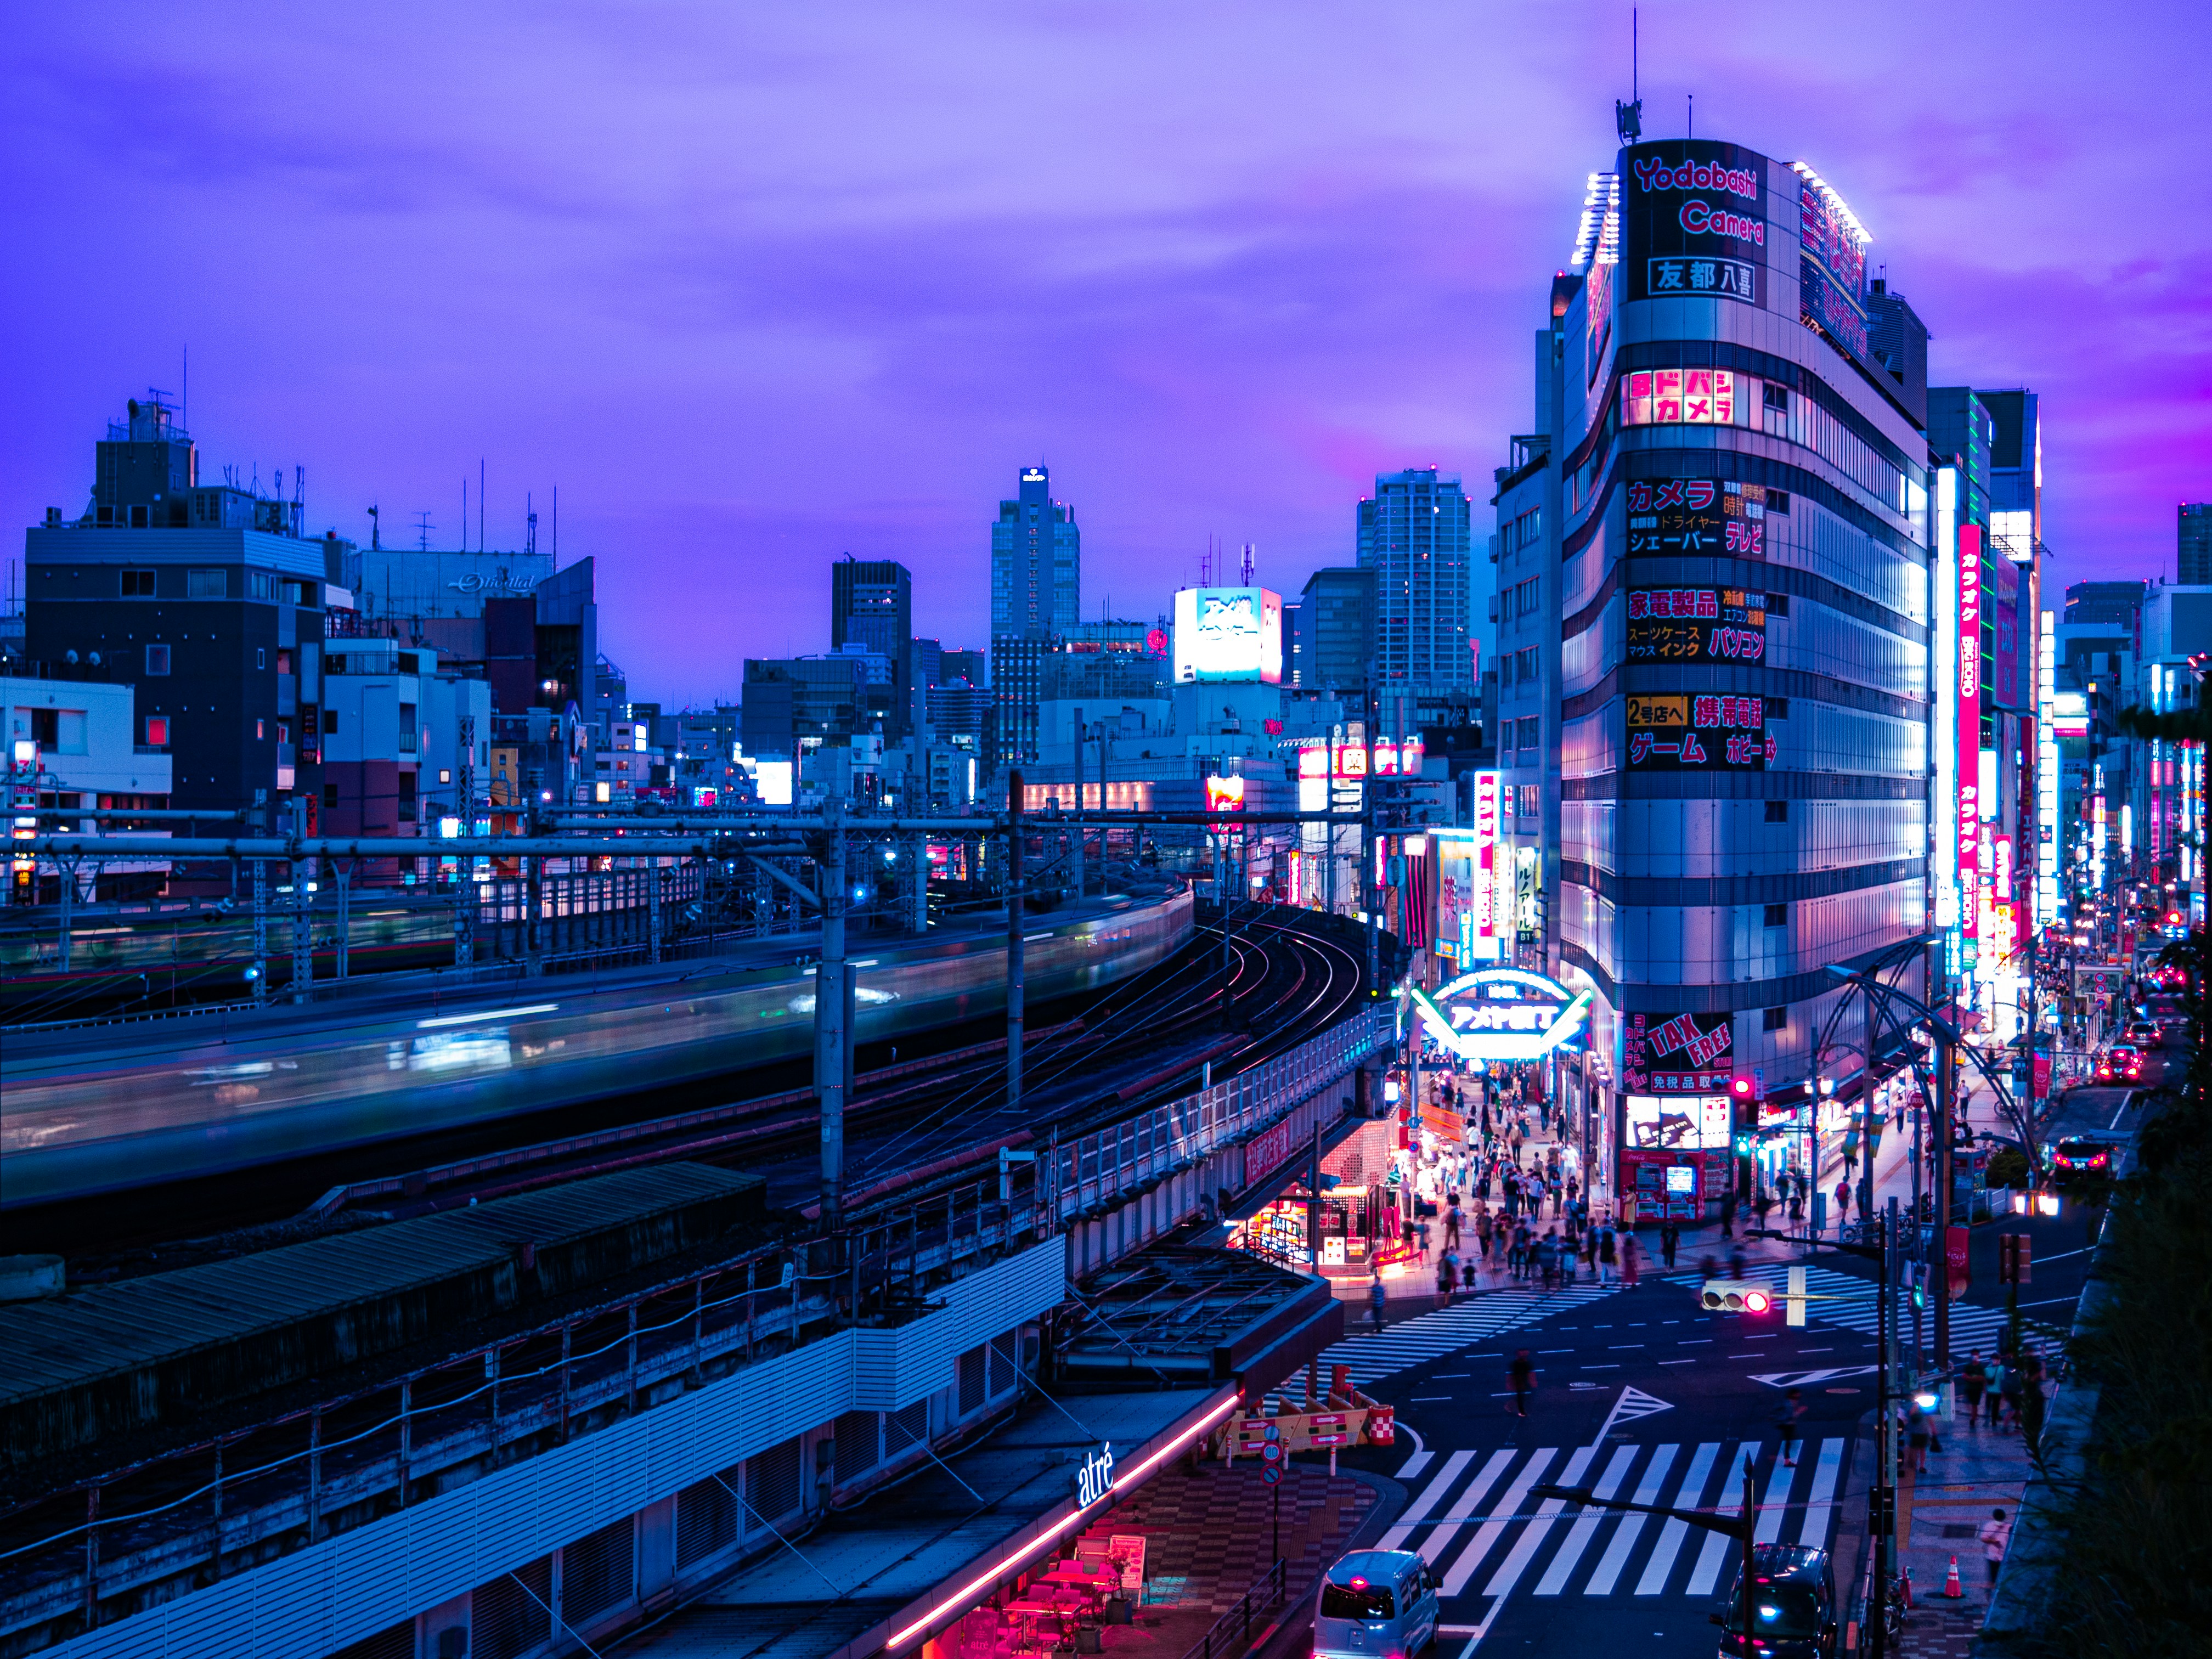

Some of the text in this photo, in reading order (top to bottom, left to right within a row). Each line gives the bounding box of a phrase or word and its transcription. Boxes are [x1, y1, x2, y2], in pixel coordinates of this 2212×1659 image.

[1635, 157, 1757, 201] Yodobashi
[1679, 200, 1763, 246] Camera
[1657, 261, 1751, 297] 友都八喜
[1630, 371, 1731, 397] ヨドバシ
[1656, 399, 1731, 421] カメラ
[1628, 481, 1714, 512] カメラ
[1724, 496, 1744, 516] 時計
[1631, 521, 1762, 554] シェーバー テレビ
[1662, 516, 1720, 529] ドライヤー
[1961, 553, 1977, 622] カラオケ
[1629, 589, 1718, 619] 家電製品
[1723, 609, 1748, 623] エアコン
[1629, 627, 1764, 658] スーツケース パソコン
[1629, 642, 1700, 657] マウス インク
[1629, 696, 1762, 729] 2号店へ 携帯電話
[1630, 733, 1707, 764] ゲーム
[1726, 734, 1762, 764] ホビー
[1960, 786, 1977, 854] カラオケ
[1519, 867, 1532, 930] ルノアール
[1625, 1027, 1633, 1065] カメラ
[1634, 1015, 1645, 1066] ヨドバシ
[1647, 1013, 1731, 1068] TAX FREE
[1623, 1068, 1637, 1084] TAX
[1630, 1074, 1648, 1090] FREE
[1079, 1441, 1114, 1507] atré
